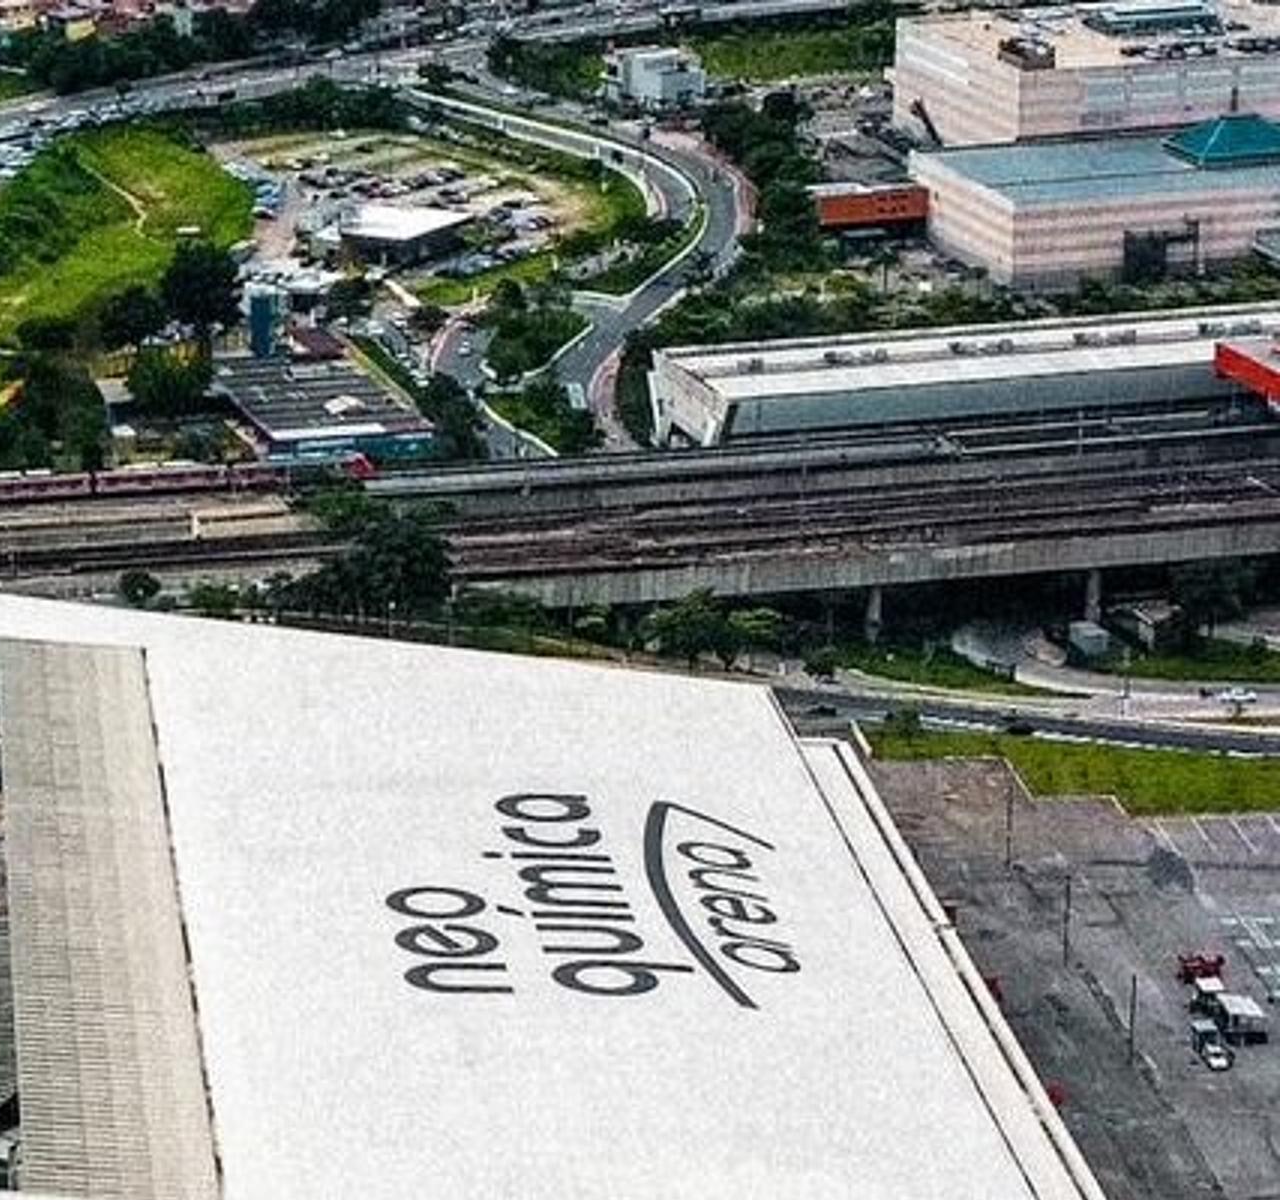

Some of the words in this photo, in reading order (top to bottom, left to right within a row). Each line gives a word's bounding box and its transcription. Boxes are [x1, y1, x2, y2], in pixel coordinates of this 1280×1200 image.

[385, 886, 514, 994] neo
[480, 792, 695, 997] química
[676, 841, 802, 974] arena
